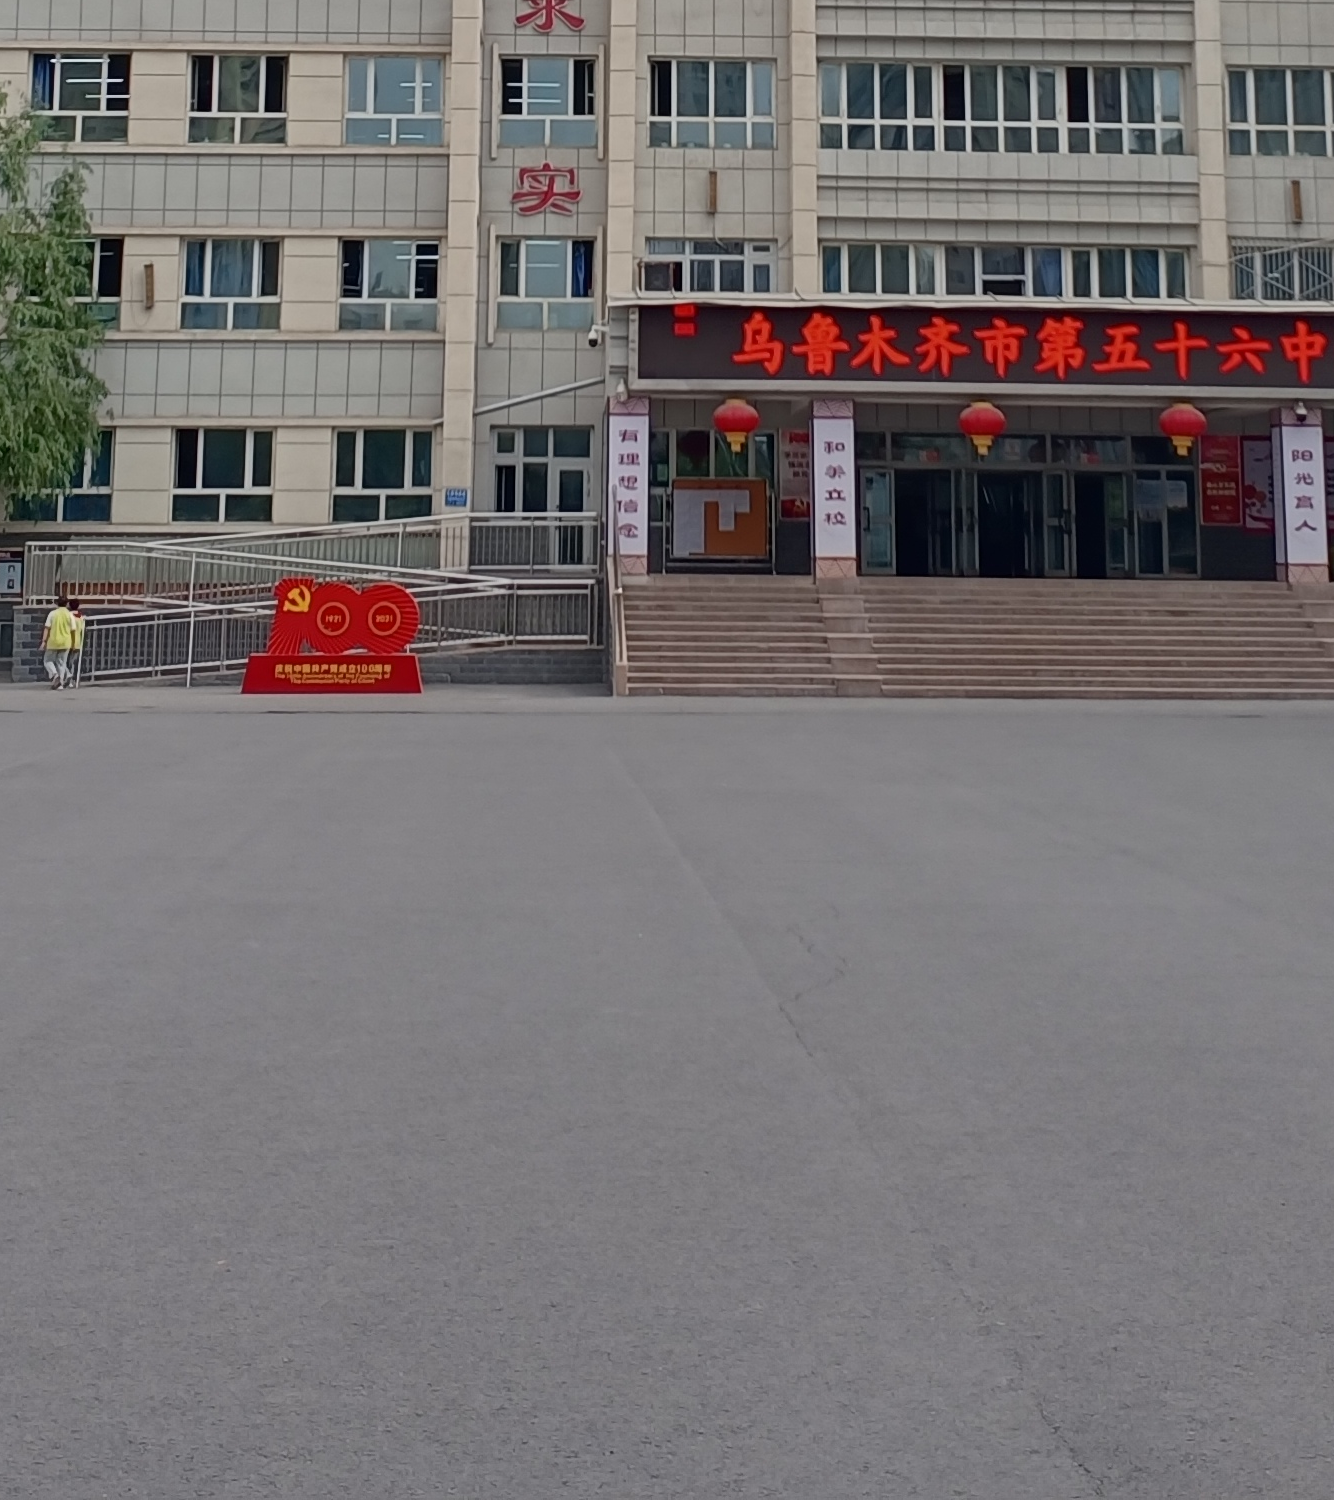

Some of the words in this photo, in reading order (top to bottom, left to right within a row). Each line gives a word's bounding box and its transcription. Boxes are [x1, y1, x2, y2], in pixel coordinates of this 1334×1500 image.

[617, 428, 641, 539] 有理想信念
